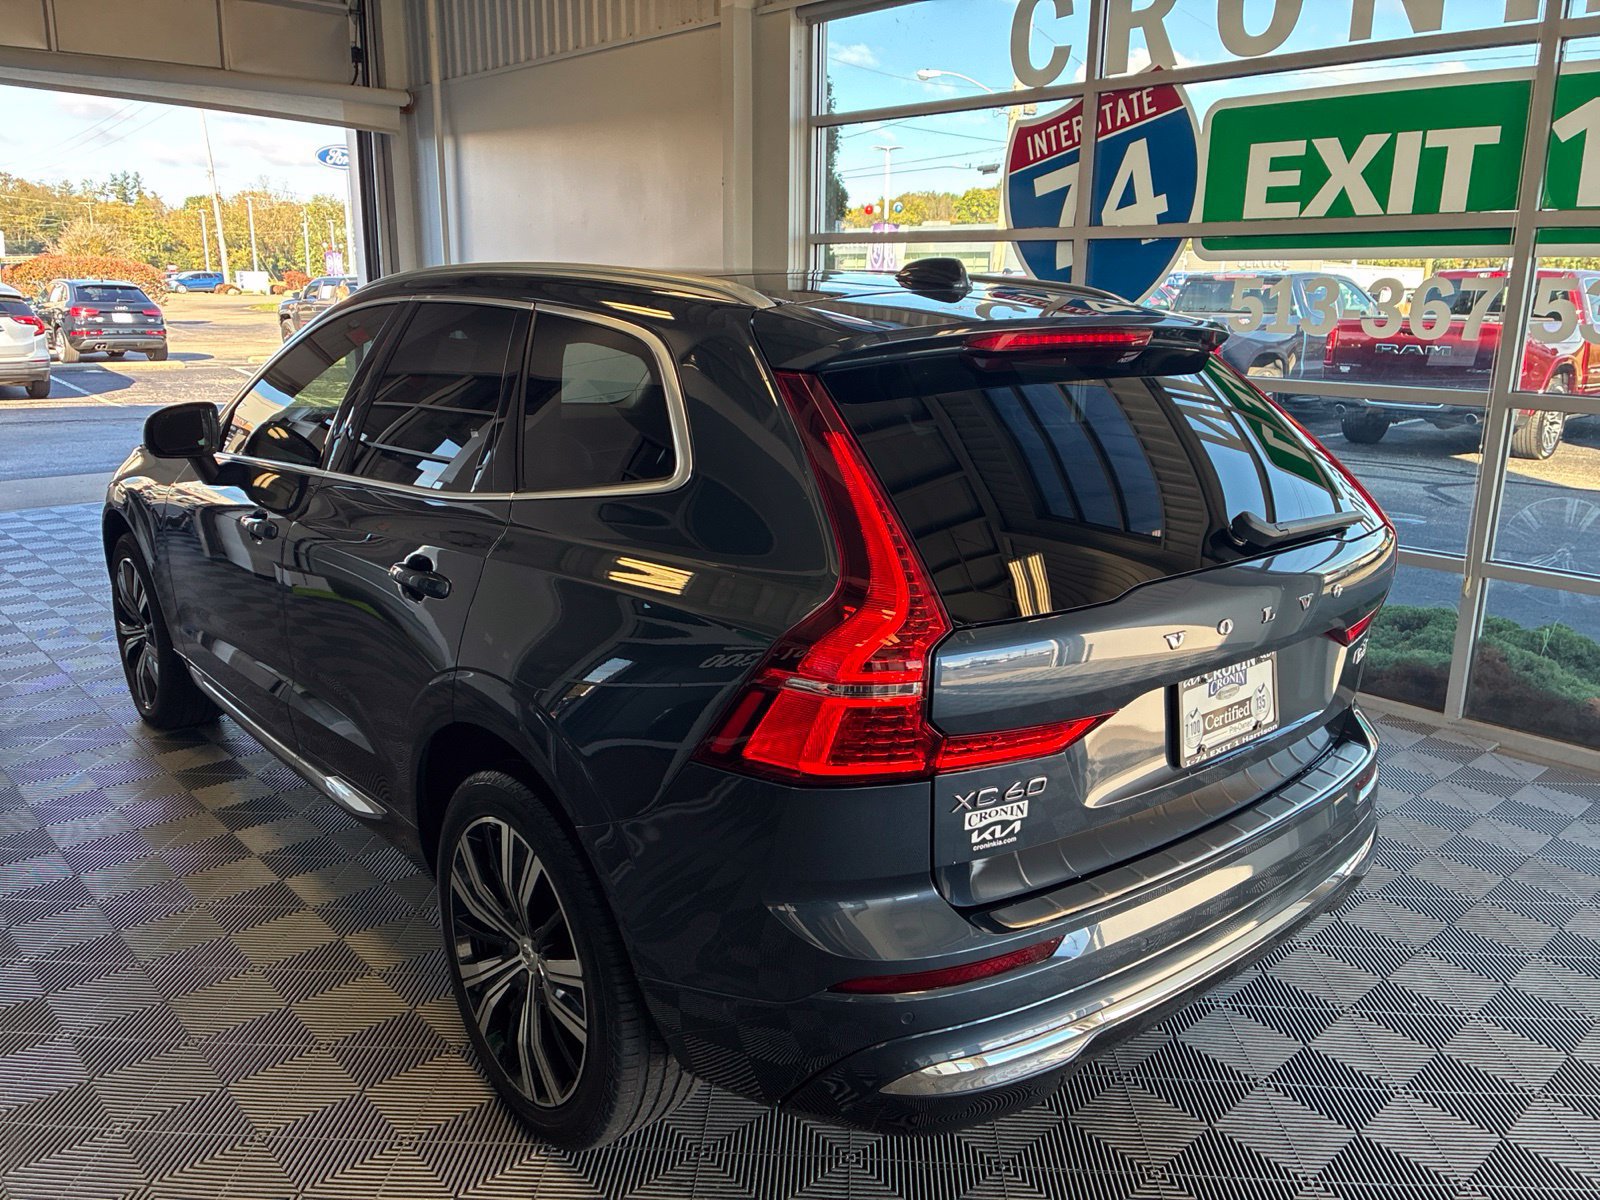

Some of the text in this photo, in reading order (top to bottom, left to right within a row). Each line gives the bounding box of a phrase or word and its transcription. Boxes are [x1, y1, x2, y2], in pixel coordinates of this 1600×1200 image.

[1026, 87, 1157, 161] INTERTATE
[326, 148, 349, 165] For
[1242, 125, 1502, 219] EXIT
[1033, 138, 1168, 270] 74
[1374, 343, 1452, 357] RAM
[1163, 583, 1344, 650] VOLVO
[1210, 670, 1245, 695] CRONIN
[1204, 700, 1251, 730] Certified
[1185, 753, 1208, 767] I-74
[1209, 742, 1232, 758] EXIT
[1242, 723, 1278, 743] Harrison
[967, 801, 1027, 828] CRONIN
[971, 820, 1022, 844] KIA
[972, 836, 1017, 852] croninkia.com
